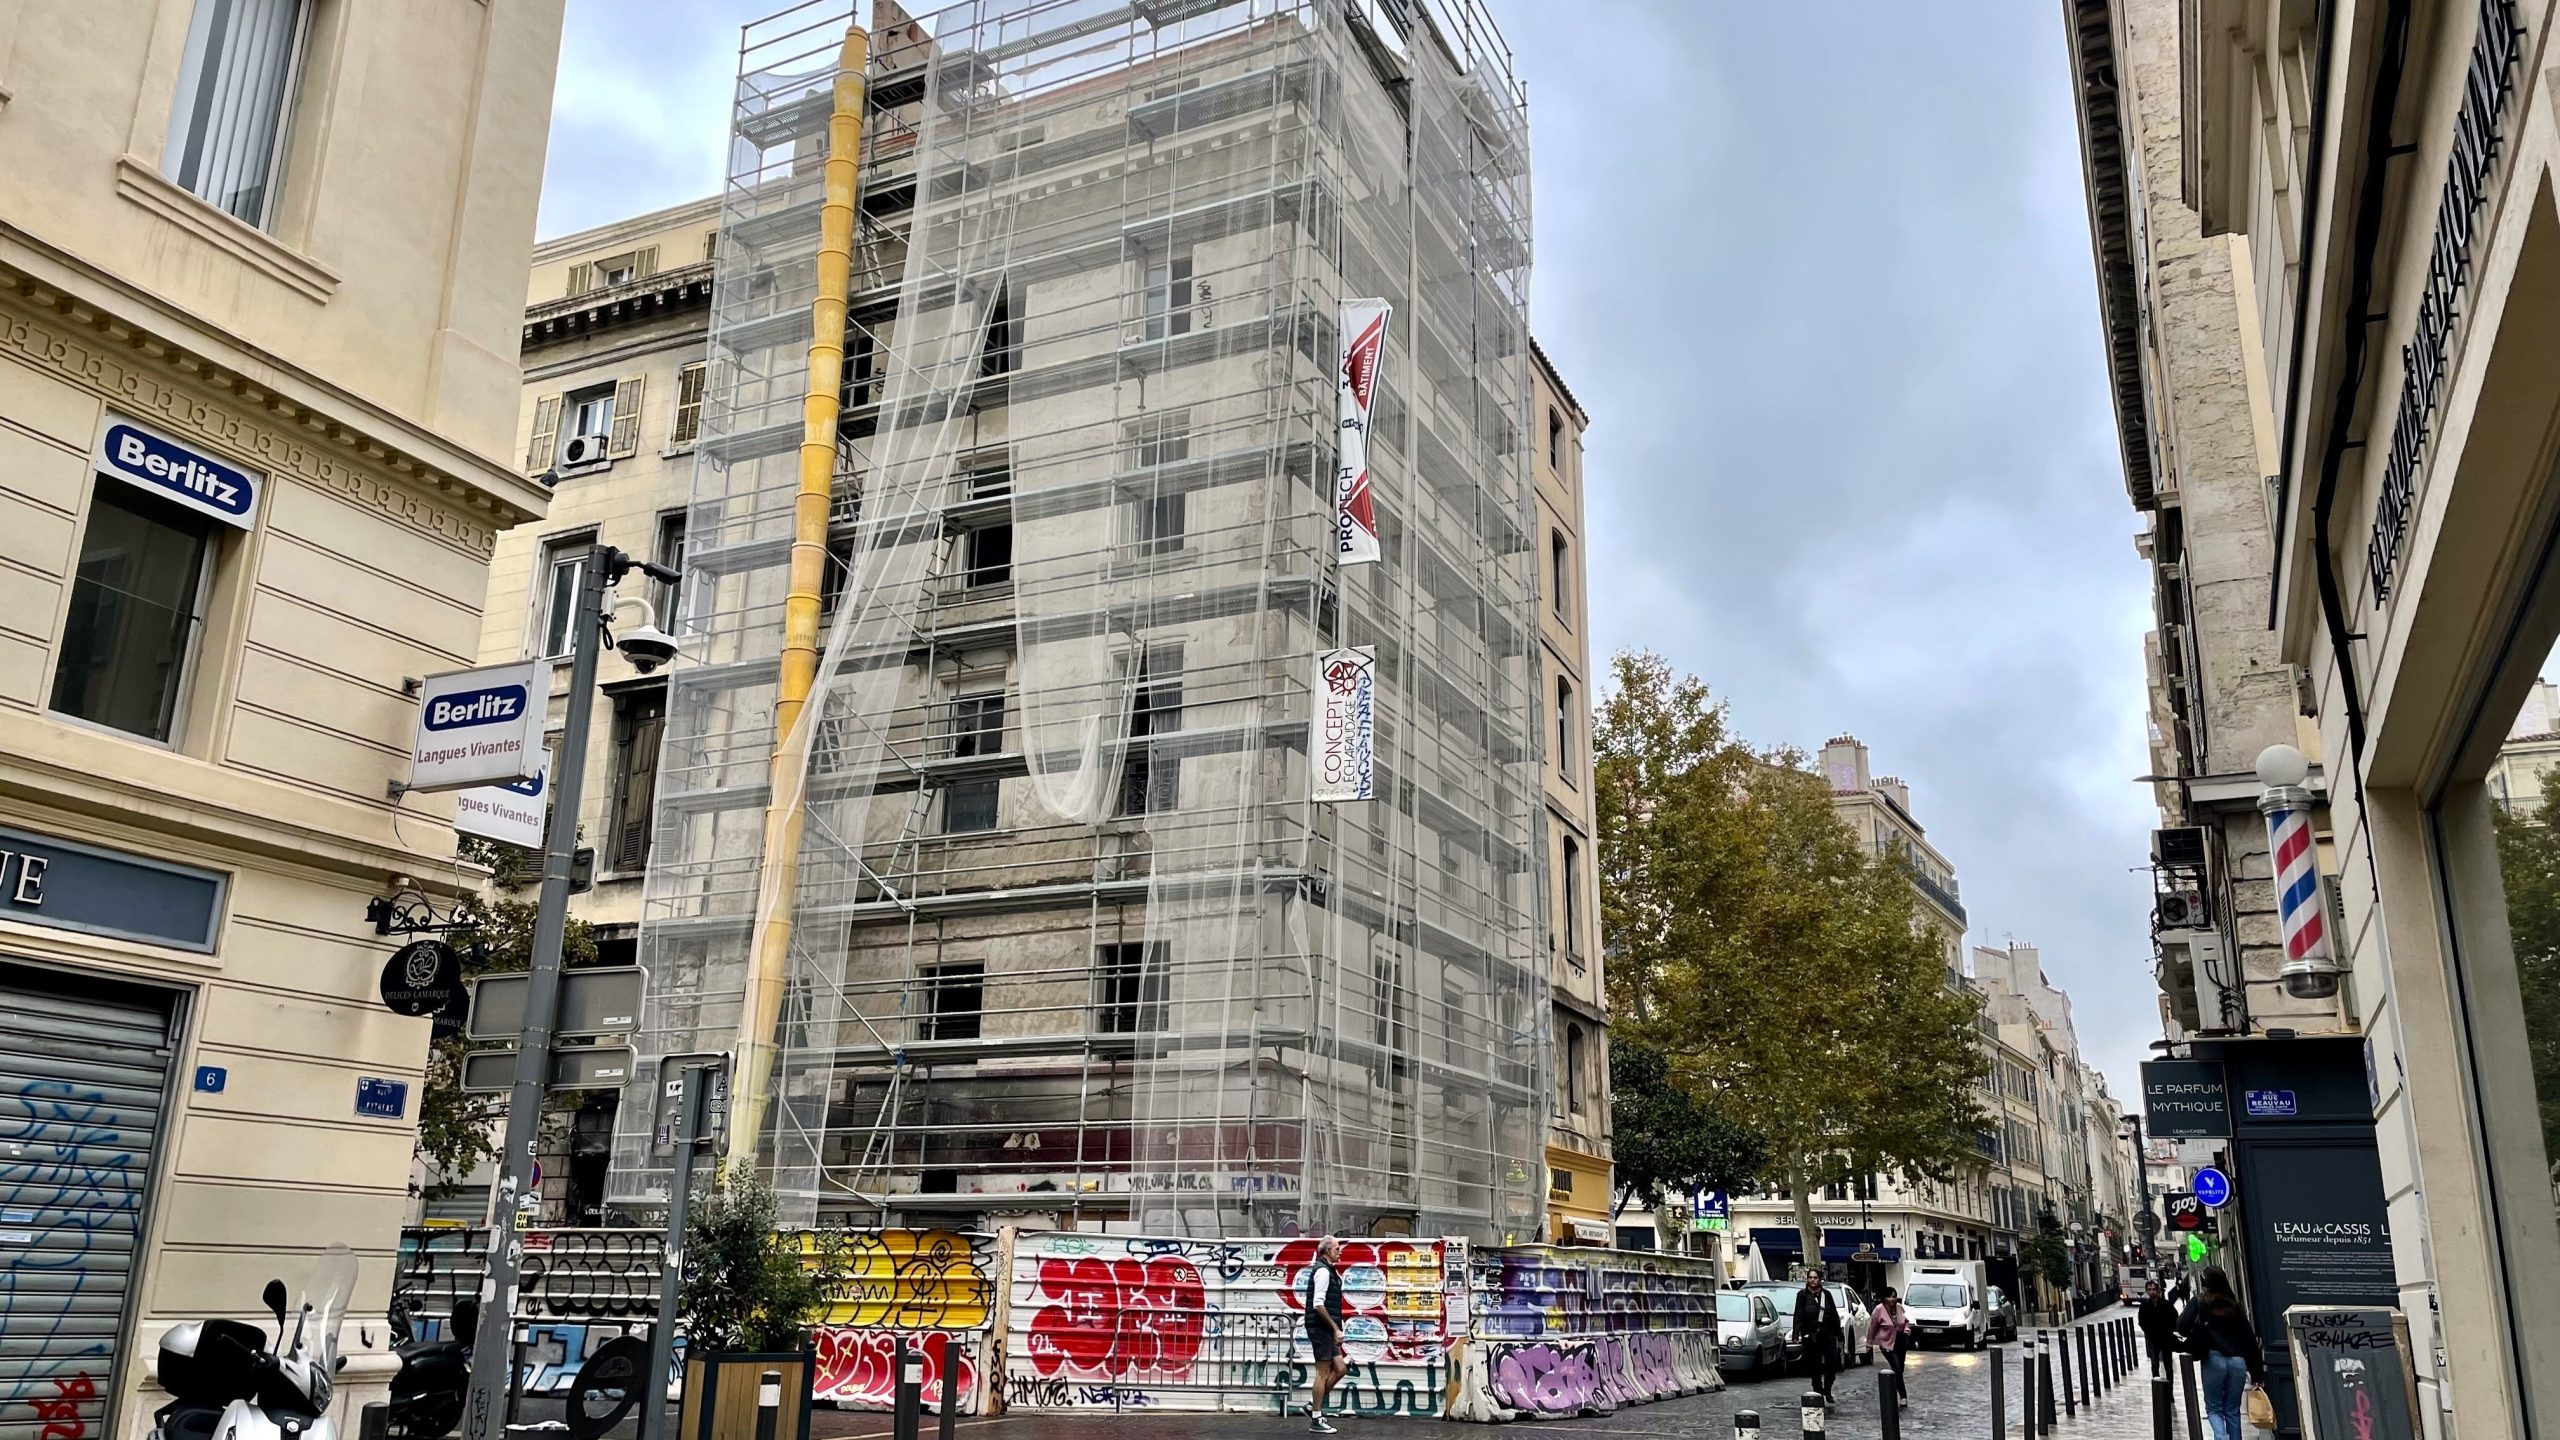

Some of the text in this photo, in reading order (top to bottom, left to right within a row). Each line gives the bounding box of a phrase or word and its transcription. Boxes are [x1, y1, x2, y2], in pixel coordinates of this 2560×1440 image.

[1358, 346, 1375, 397] BÂTIMENT
[117, 433, 239, 507] Berlitz
[432, 694, 518, 725] Berlitz
[417, 738, 521, 764] Langues Vivantes
[1325, 698, 1343, 784] CONCEPT
[492, 802, 539, 826] Vivantes
[206, 1072, 216, 1086] 6
[2148, 1084, 2223, 1095] LE PARFUM
[2152, 1101, 2224, 1112] MYTHIQUE
[2171, 1196, 2198, 1216] Joy
[2274, 1222, 2310, 1234] L'EAU
[2324, 1223, 2371, 1235] CASSIS
[2276, 1234, 2371, 1245] Parfumeur depuis 1851
